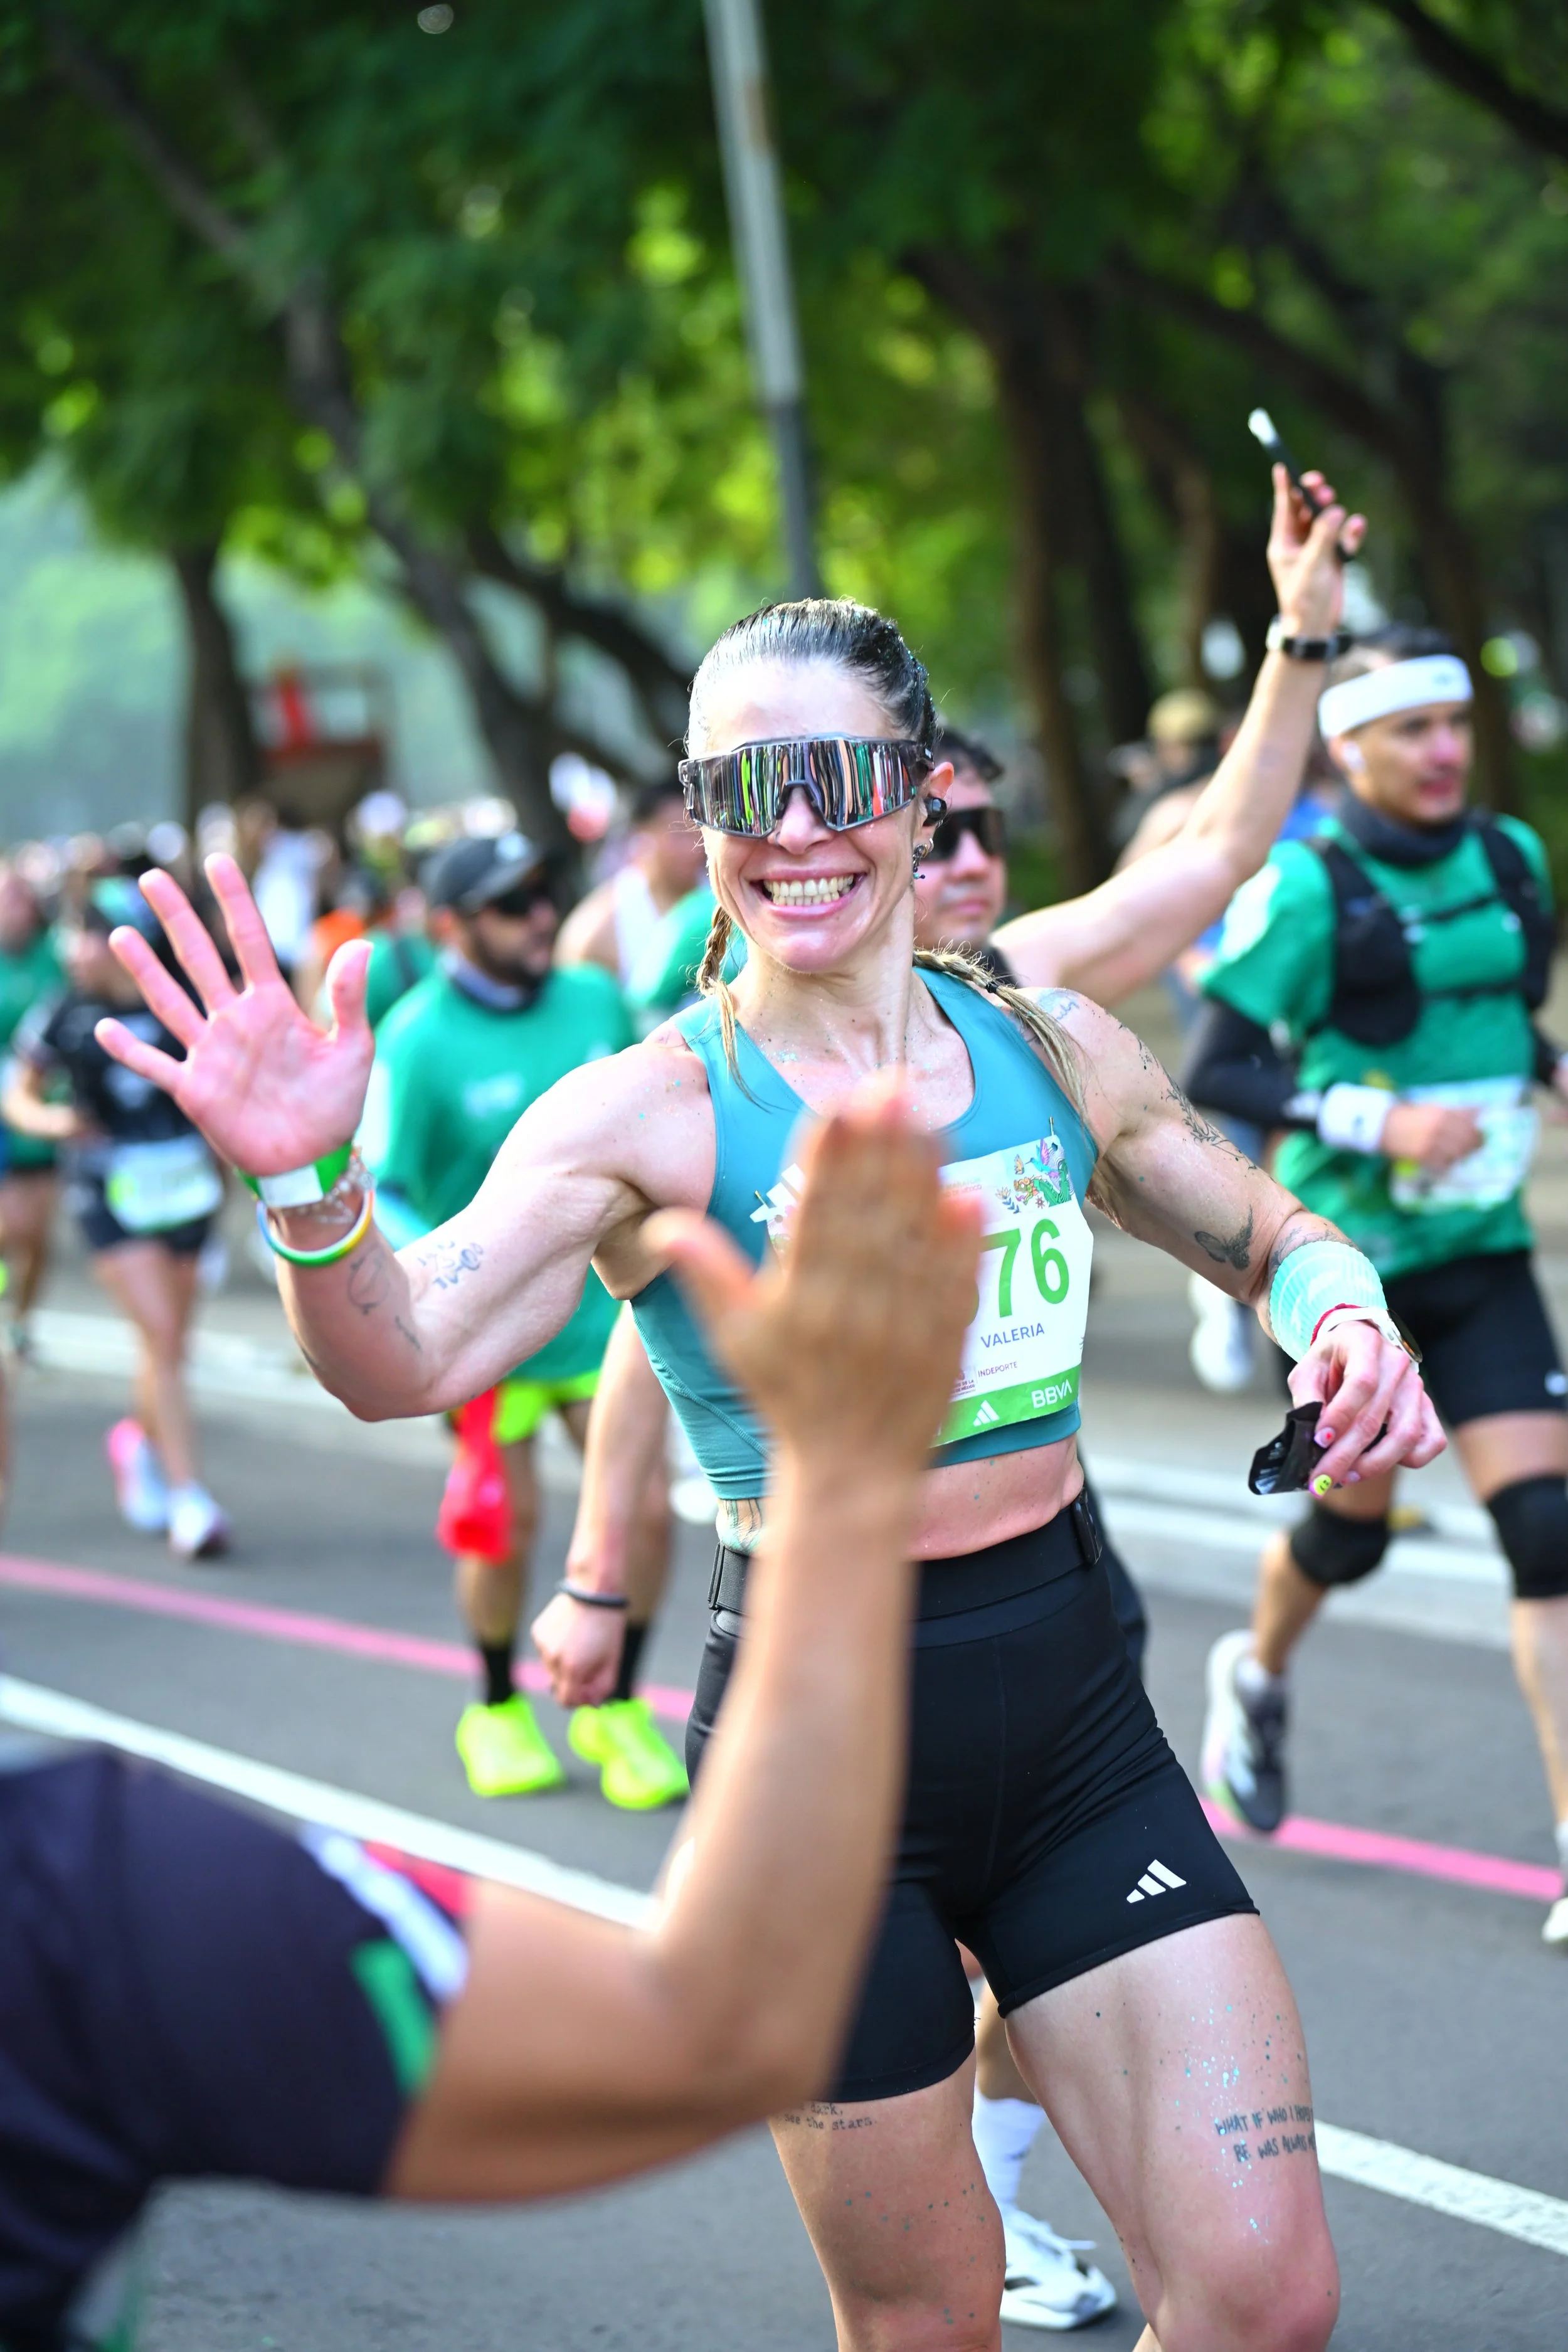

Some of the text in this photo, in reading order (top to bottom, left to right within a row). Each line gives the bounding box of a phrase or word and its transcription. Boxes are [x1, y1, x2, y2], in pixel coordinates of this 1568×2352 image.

[980, 1323, 1045, 1348] VALERIA
[978, 1360, 1018, 1378] INDEPORTE
[1030, 1379, 1073, 1409] BBVA
[784, 2113, 801, 2125] see
[807, 2116, 824, 2129] the
[1214, 2114, 1249, 2136] WHAT
[1267, 2106, 1288, 2125] WHO
[1258, 2137, 1279, 2159] WAS
